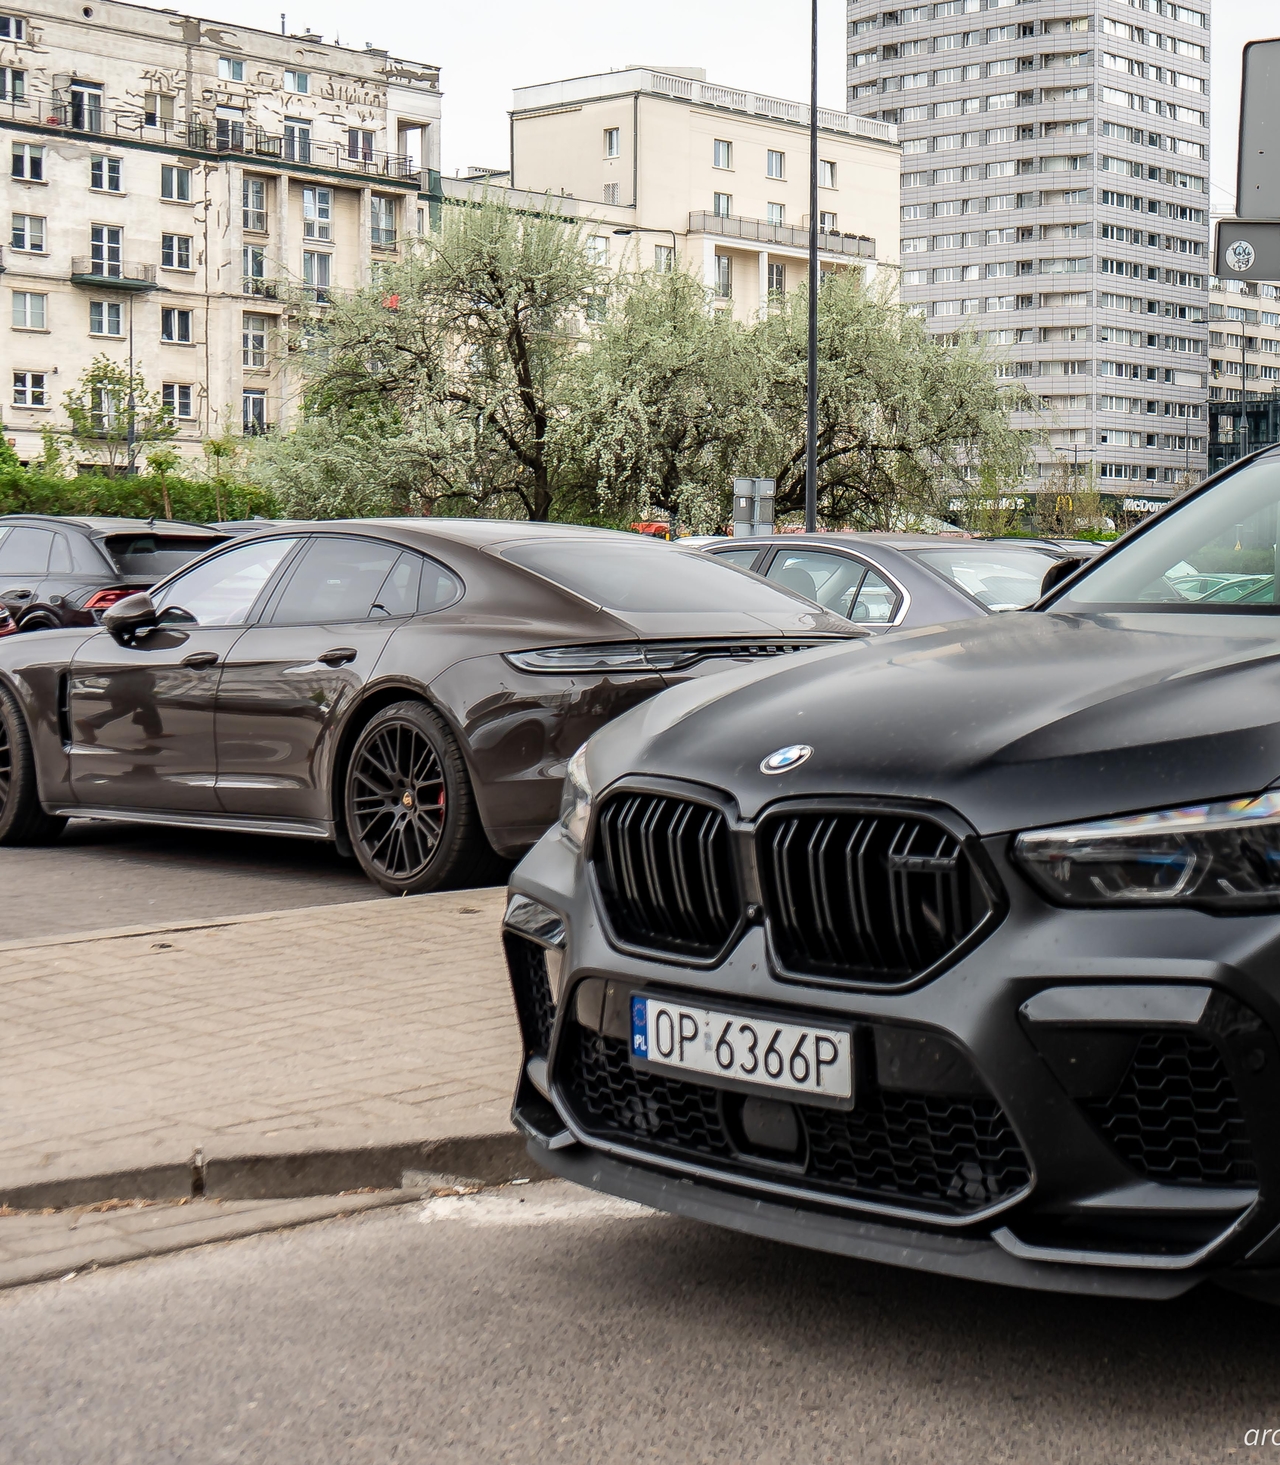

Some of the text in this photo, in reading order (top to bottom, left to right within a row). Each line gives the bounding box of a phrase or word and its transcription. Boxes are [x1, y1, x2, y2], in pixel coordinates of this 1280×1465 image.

[634, 1034, 648, 1051] PL
[655, 1007, 839, 1087] OP 6366P
